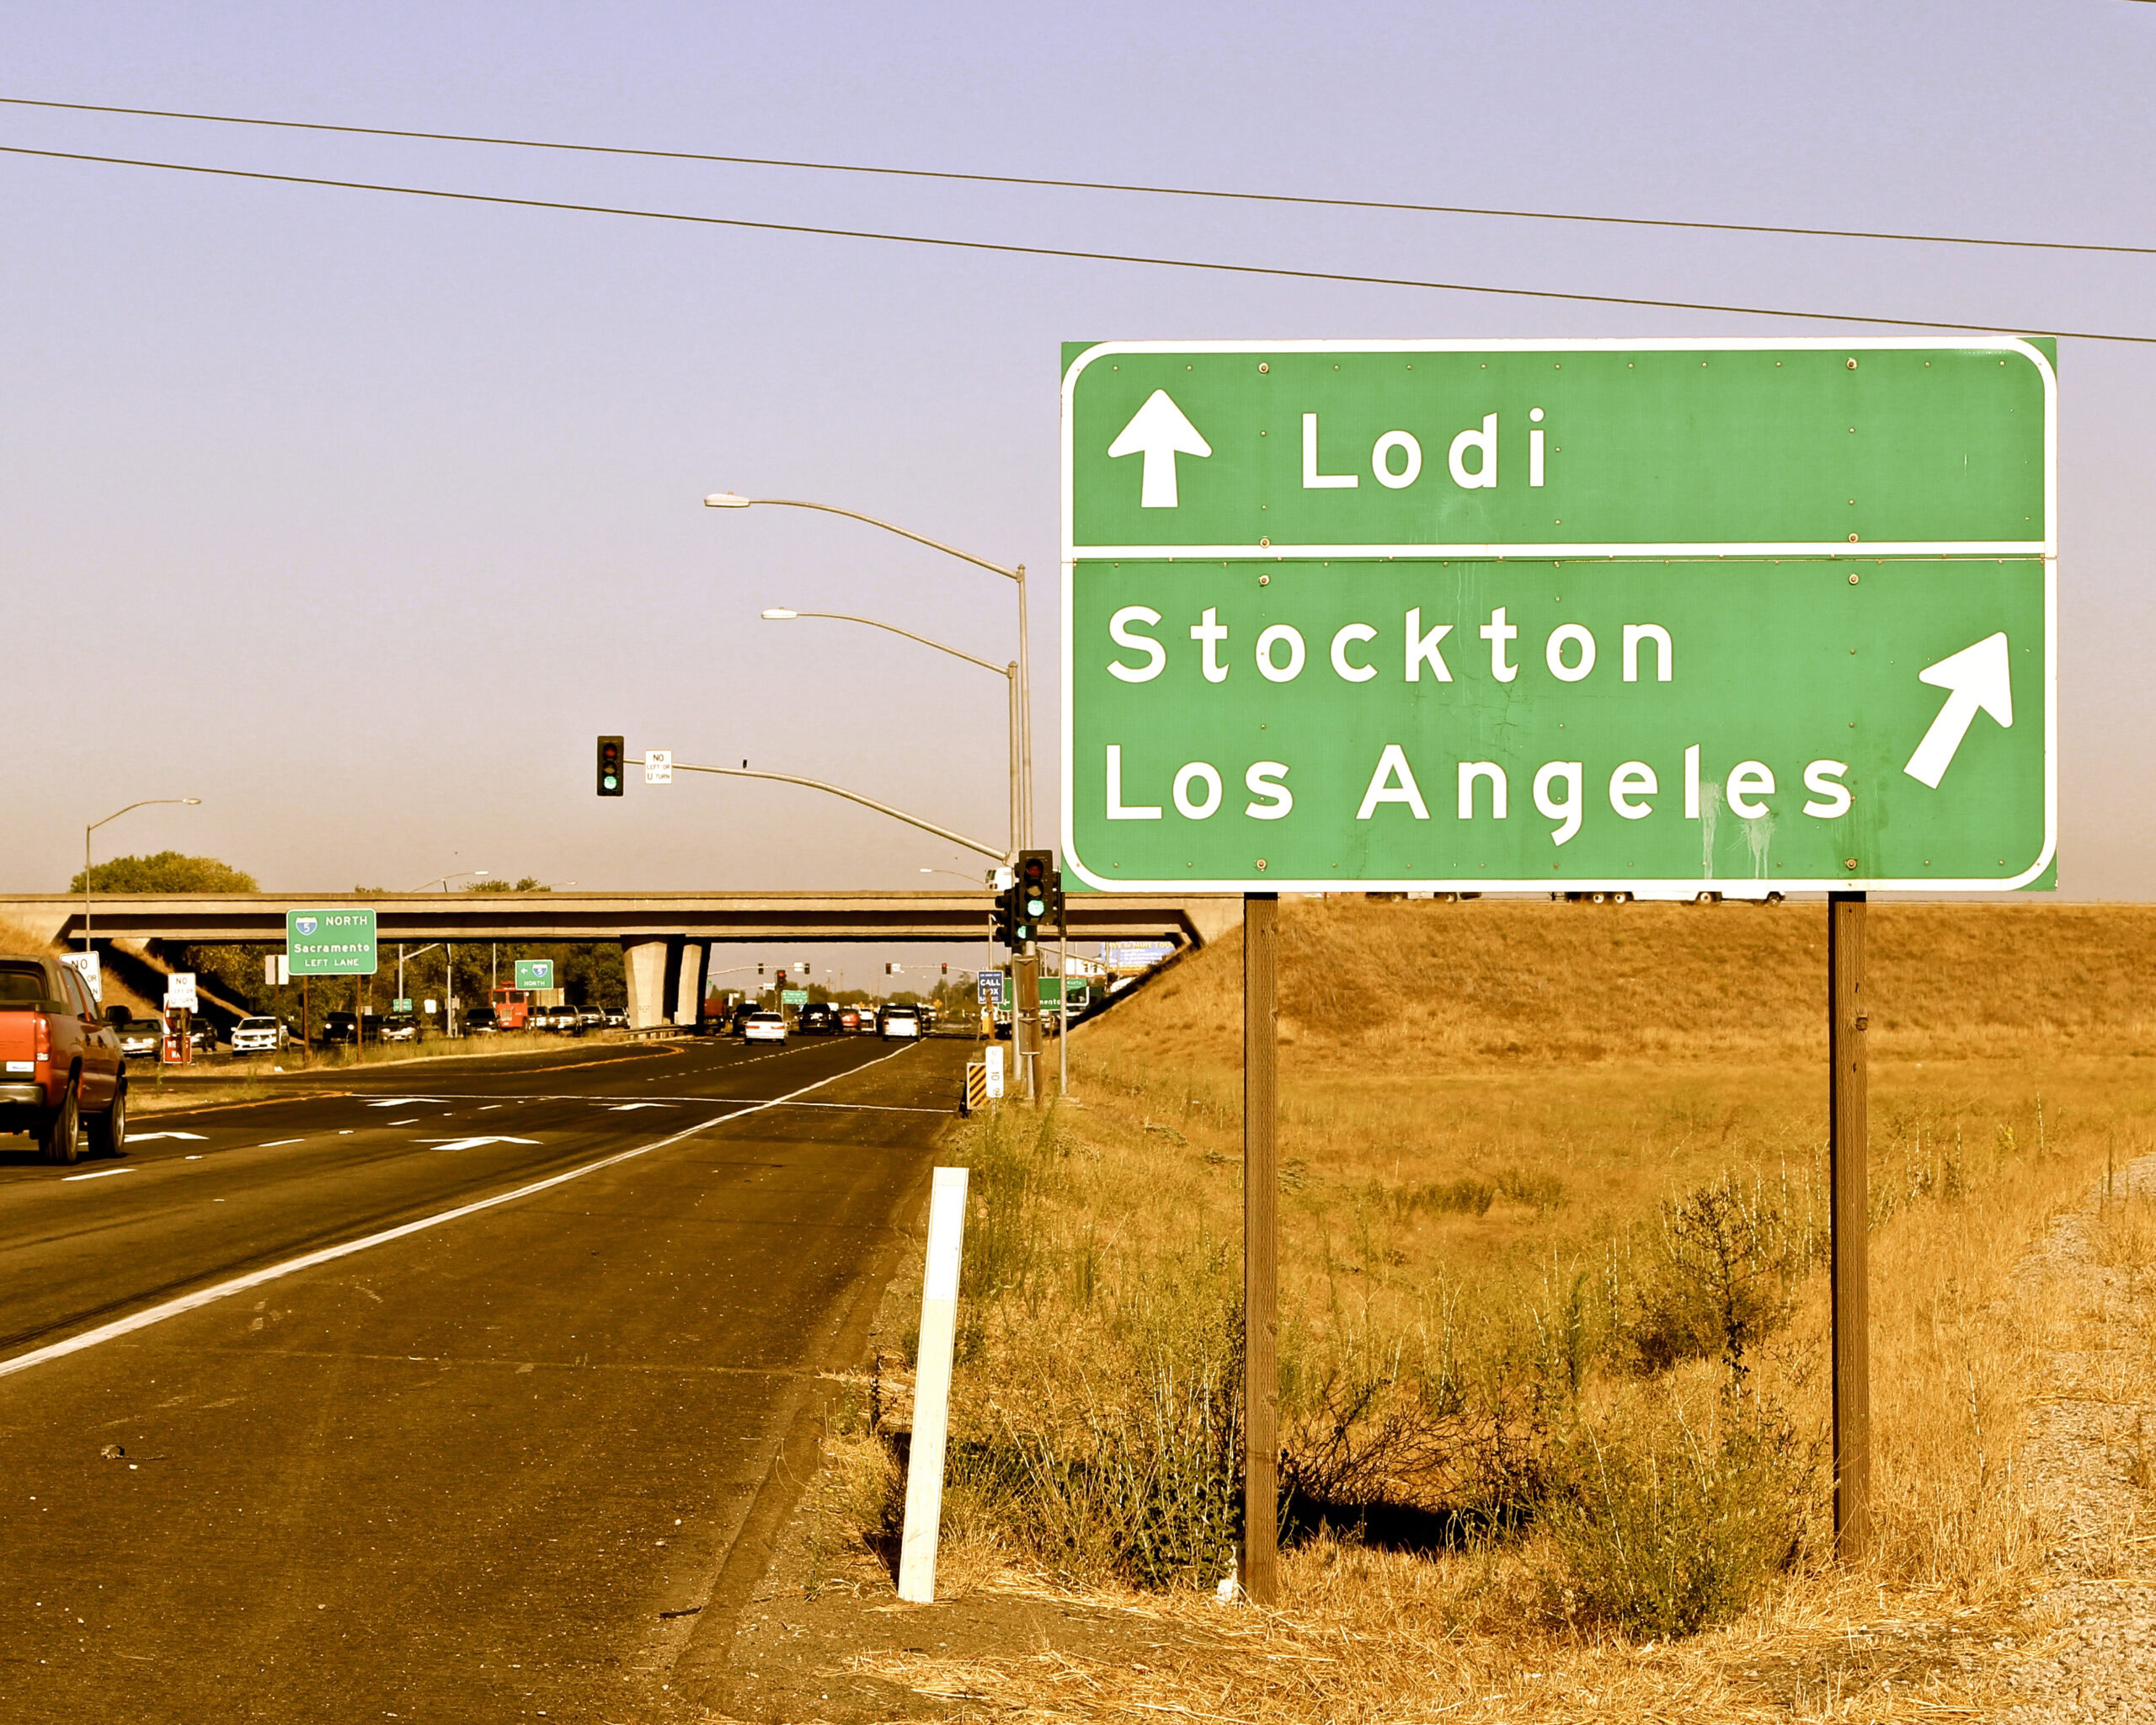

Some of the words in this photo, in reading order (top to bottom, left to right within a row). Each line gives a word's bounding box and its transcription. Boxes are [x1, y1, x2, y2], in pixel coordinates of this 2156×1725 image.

[1302, 408, 1544, 489] Lodi
[1107, 606, 1673, 683] Stockton
[653, 754, 664, 762] NO
[647, 772, 654, 781] U
[1106, 745, 1293, 820] Los
[1357, 744, 1851, 846] Angeles
[303, 923, 310, 932] 5
[325, 916, 368, 926] NORTH
[294, 943, 371, 953] Sacramento
[72, 959, 88, 970] NO
[305, 959, 328, 967] LEFT
[175, 976, 188, 985] NO
